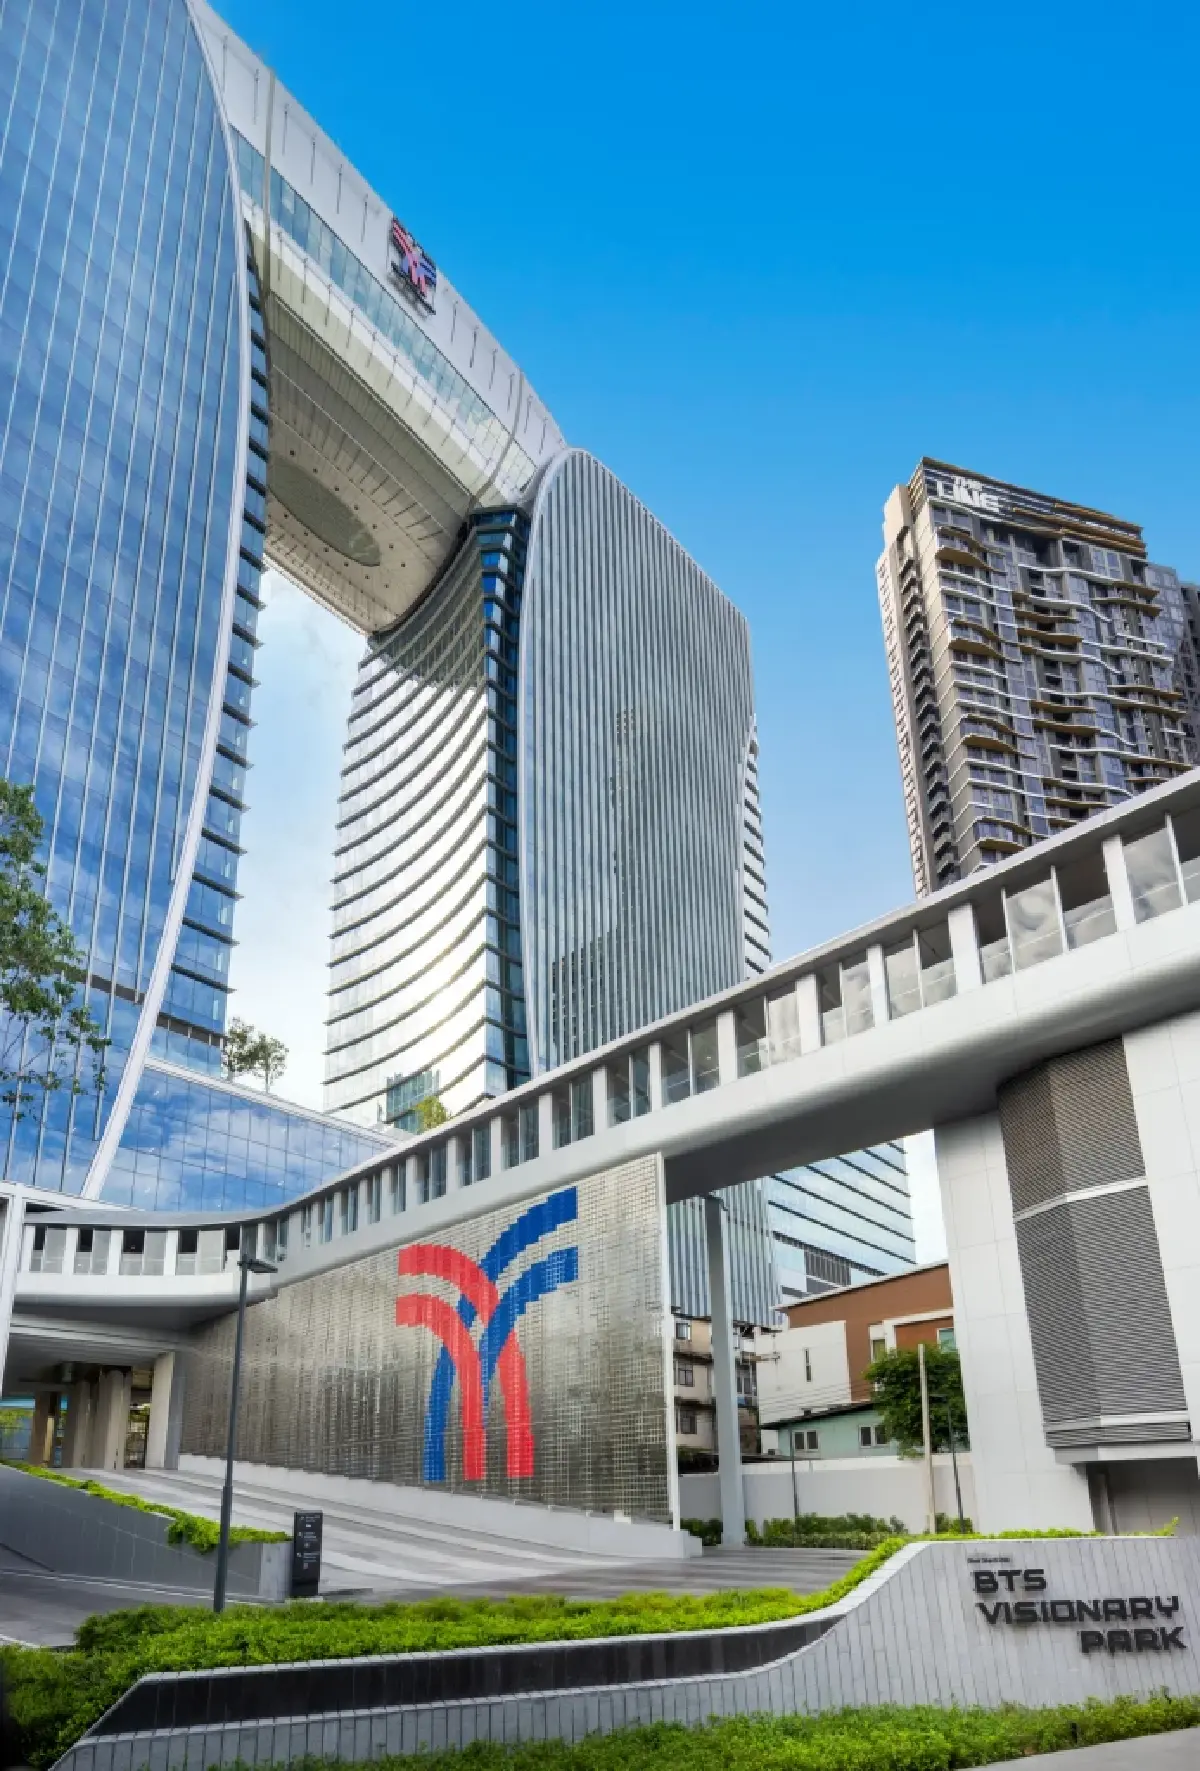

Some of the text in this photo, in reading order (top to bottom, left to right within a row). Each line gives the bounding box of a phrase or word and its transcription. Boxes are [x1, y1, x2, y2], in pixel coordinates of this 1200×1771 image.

[973, 1569, 1047, 1594] BTS
[976, 1596, 1180, 1625] VISIONARY
[1079, 1627, 1187, 1654] PARK
